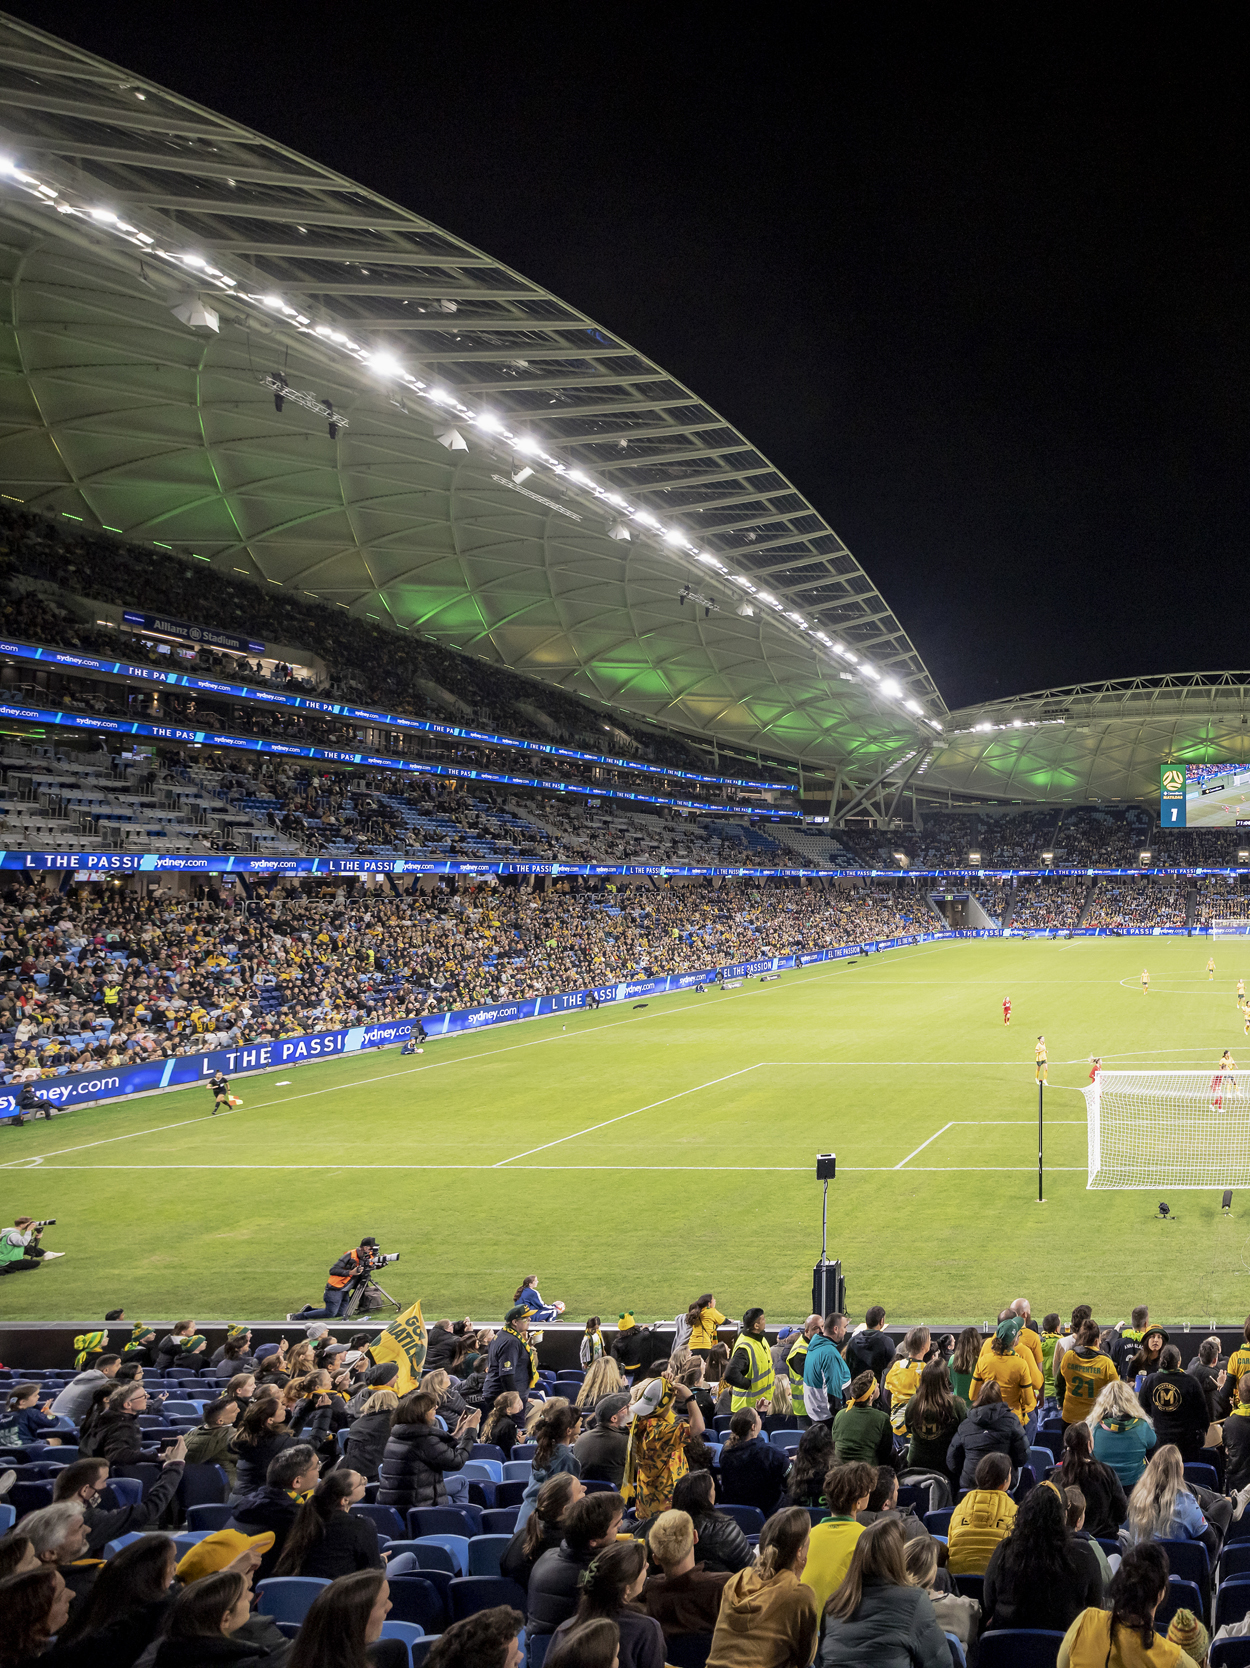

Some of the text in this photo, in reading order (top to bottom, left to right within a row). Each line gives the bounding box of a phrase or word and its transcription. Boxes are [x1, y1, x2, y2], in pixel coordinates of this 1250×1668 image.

[154, 620, 239, 648] Allianz Stadium
[57, 655, 99, 666] sydney.com
[129, 667, 148, 677] THE
[198, 682, 230, 691] sydney.com
[257, 693, 285, 701] sydney.com
[306, 701, 319, 709] THE
[76, 718, 117, 728] sydney.com
[153, 727, 194, 739] THE PAS
[214, 737, 246, 745] sydney.com
[272, 744, 300, 752] sydney.com
[1171, 809, 1178, 821] 1
[27, 855, 142, 869] L THE PASSI
[250, 860, 296, 869] sydney.com
[340, 861, 359, 870] THE
[364, 862, 396, 872] PASSI
[532, 865, 553, 874] PASSI
[732, 966, 745, 976] THE
[563, 994, 583, 1007] THE
[593, 987, 618, 1002] ASSI
[468, 1007, 517, 1023] sydney.com
[226, 1047, 271, 1069] THE
[283, 1038, 345, 1060] PASSI
[1067, 1363, 1101, 1374] CARPENTER
[1071, 1376, 1094, 1398] 21
[1160, 1393, 1175, 1404] M
